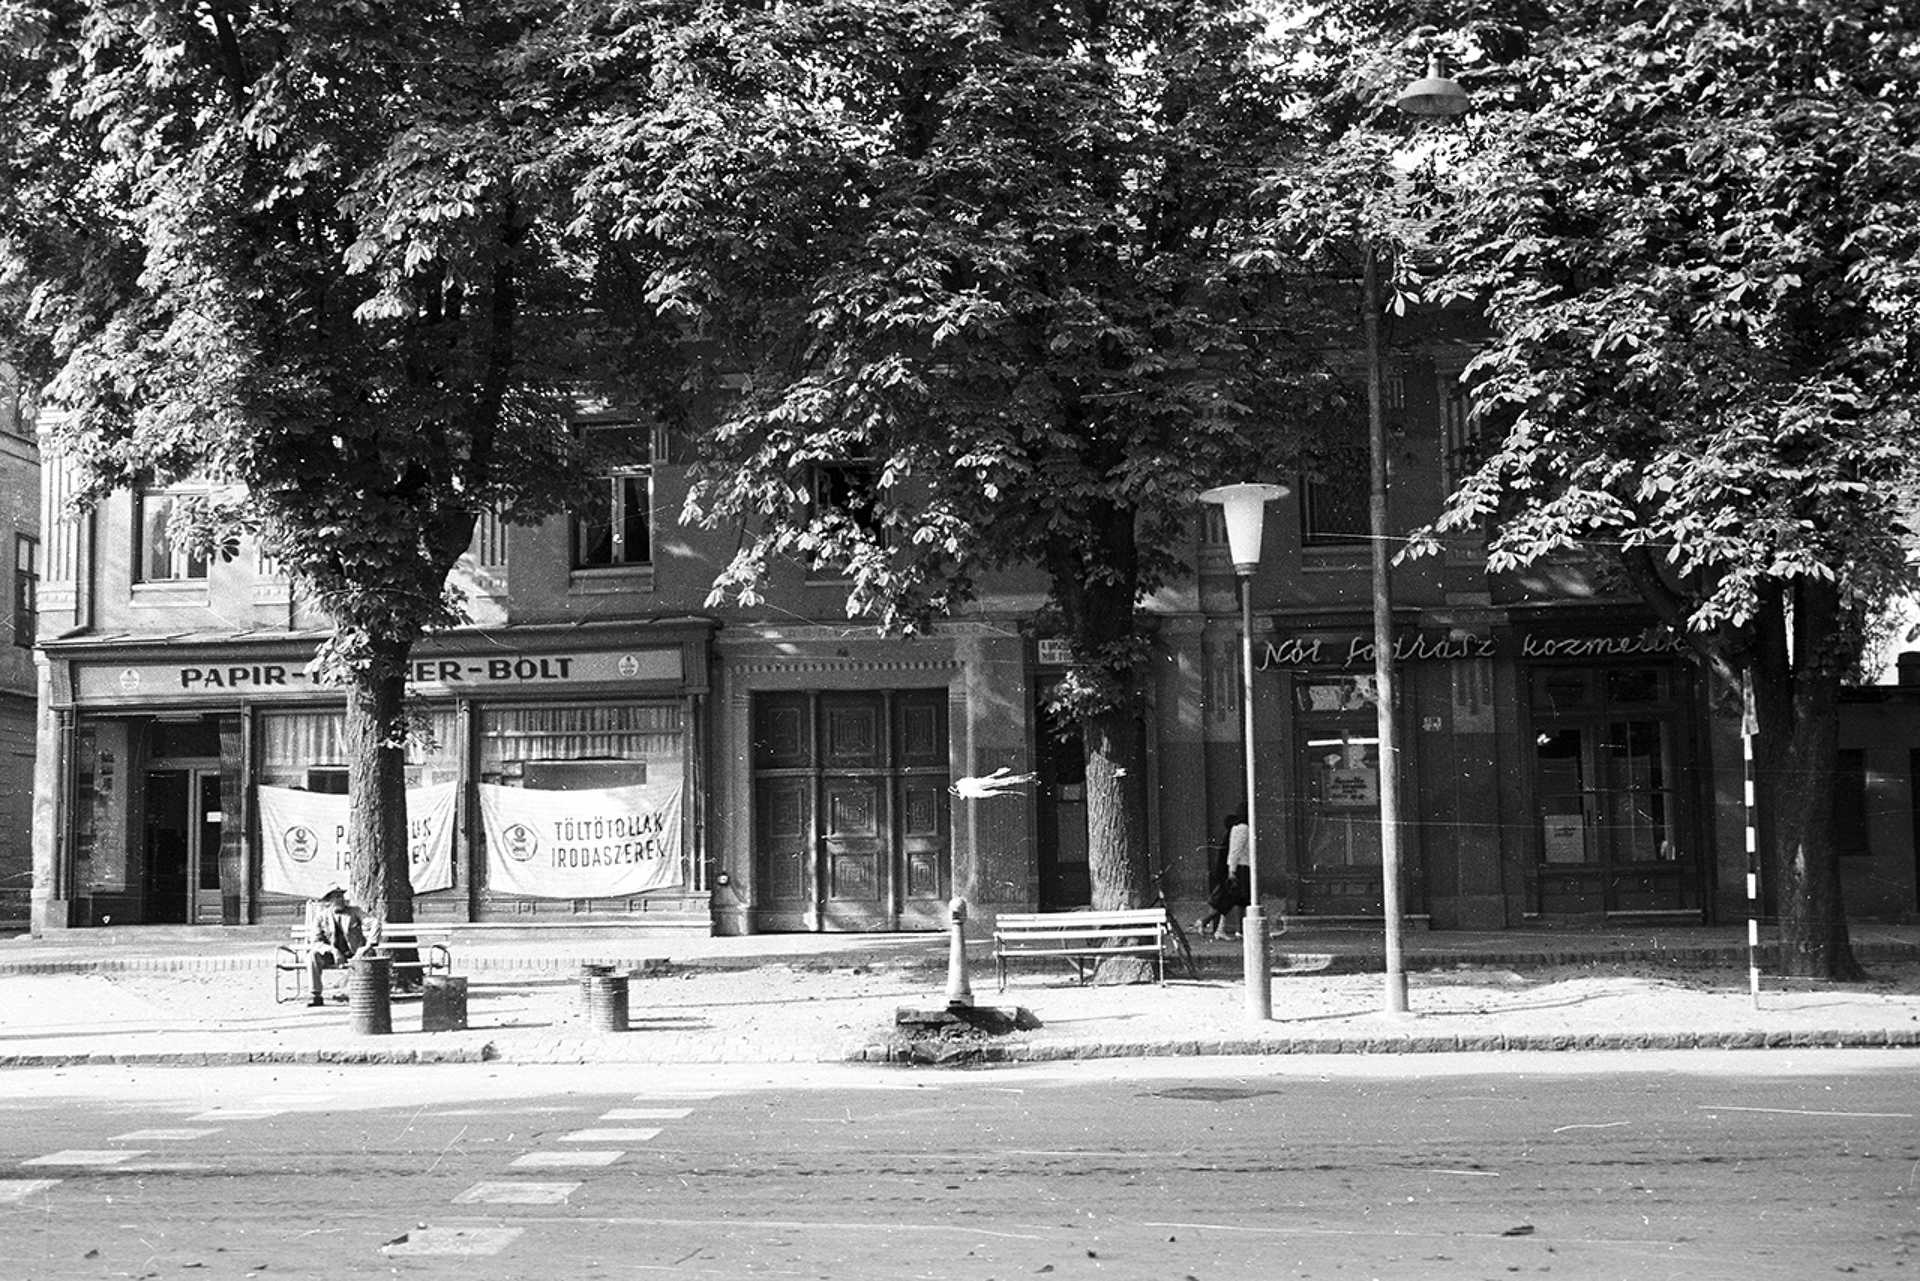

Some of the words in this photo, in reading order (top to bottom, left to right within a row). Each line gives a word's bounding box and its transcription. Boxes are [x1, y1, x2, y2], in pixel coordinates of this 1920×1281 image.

[1521, 629, 1691, 657] kozmetik
[553, 812, 664, 841] TÖLTÖTOLLAK
[551, 838, 666, 868] IRODASZEREK
